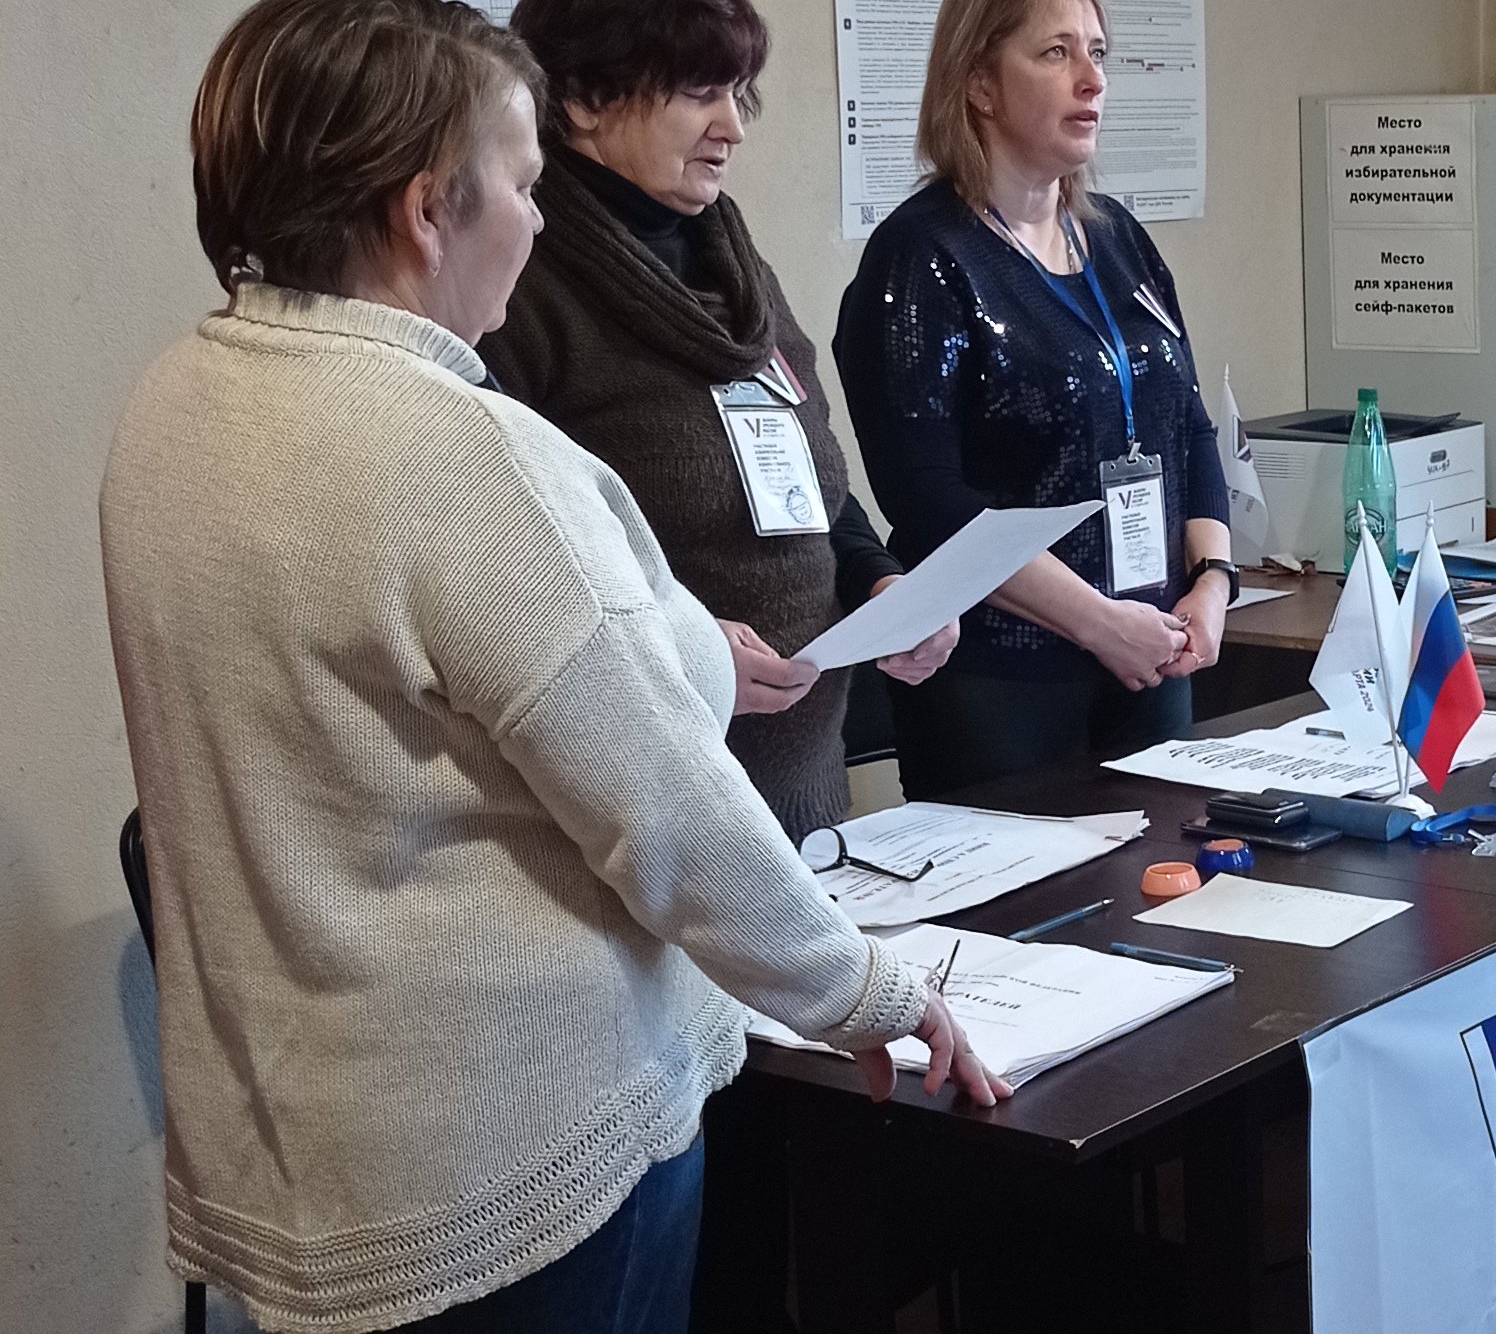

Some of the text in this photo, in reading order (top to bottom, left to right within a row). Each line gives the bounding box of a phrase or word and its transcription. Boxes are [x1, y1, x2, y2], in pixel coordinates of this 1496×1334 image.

[1377, 116, 1422, 130] Место
[1350, 144, 1450, 157] для хранения
[1345, 165, 1456, 181] избирательной
[1349, 191, 1454, 205] документации
[1380, 252, 1425, 265] Место
[1354, 279, 1453, 292] для хранения
[1354, 300, 1454, 315] сейф-пакетов
